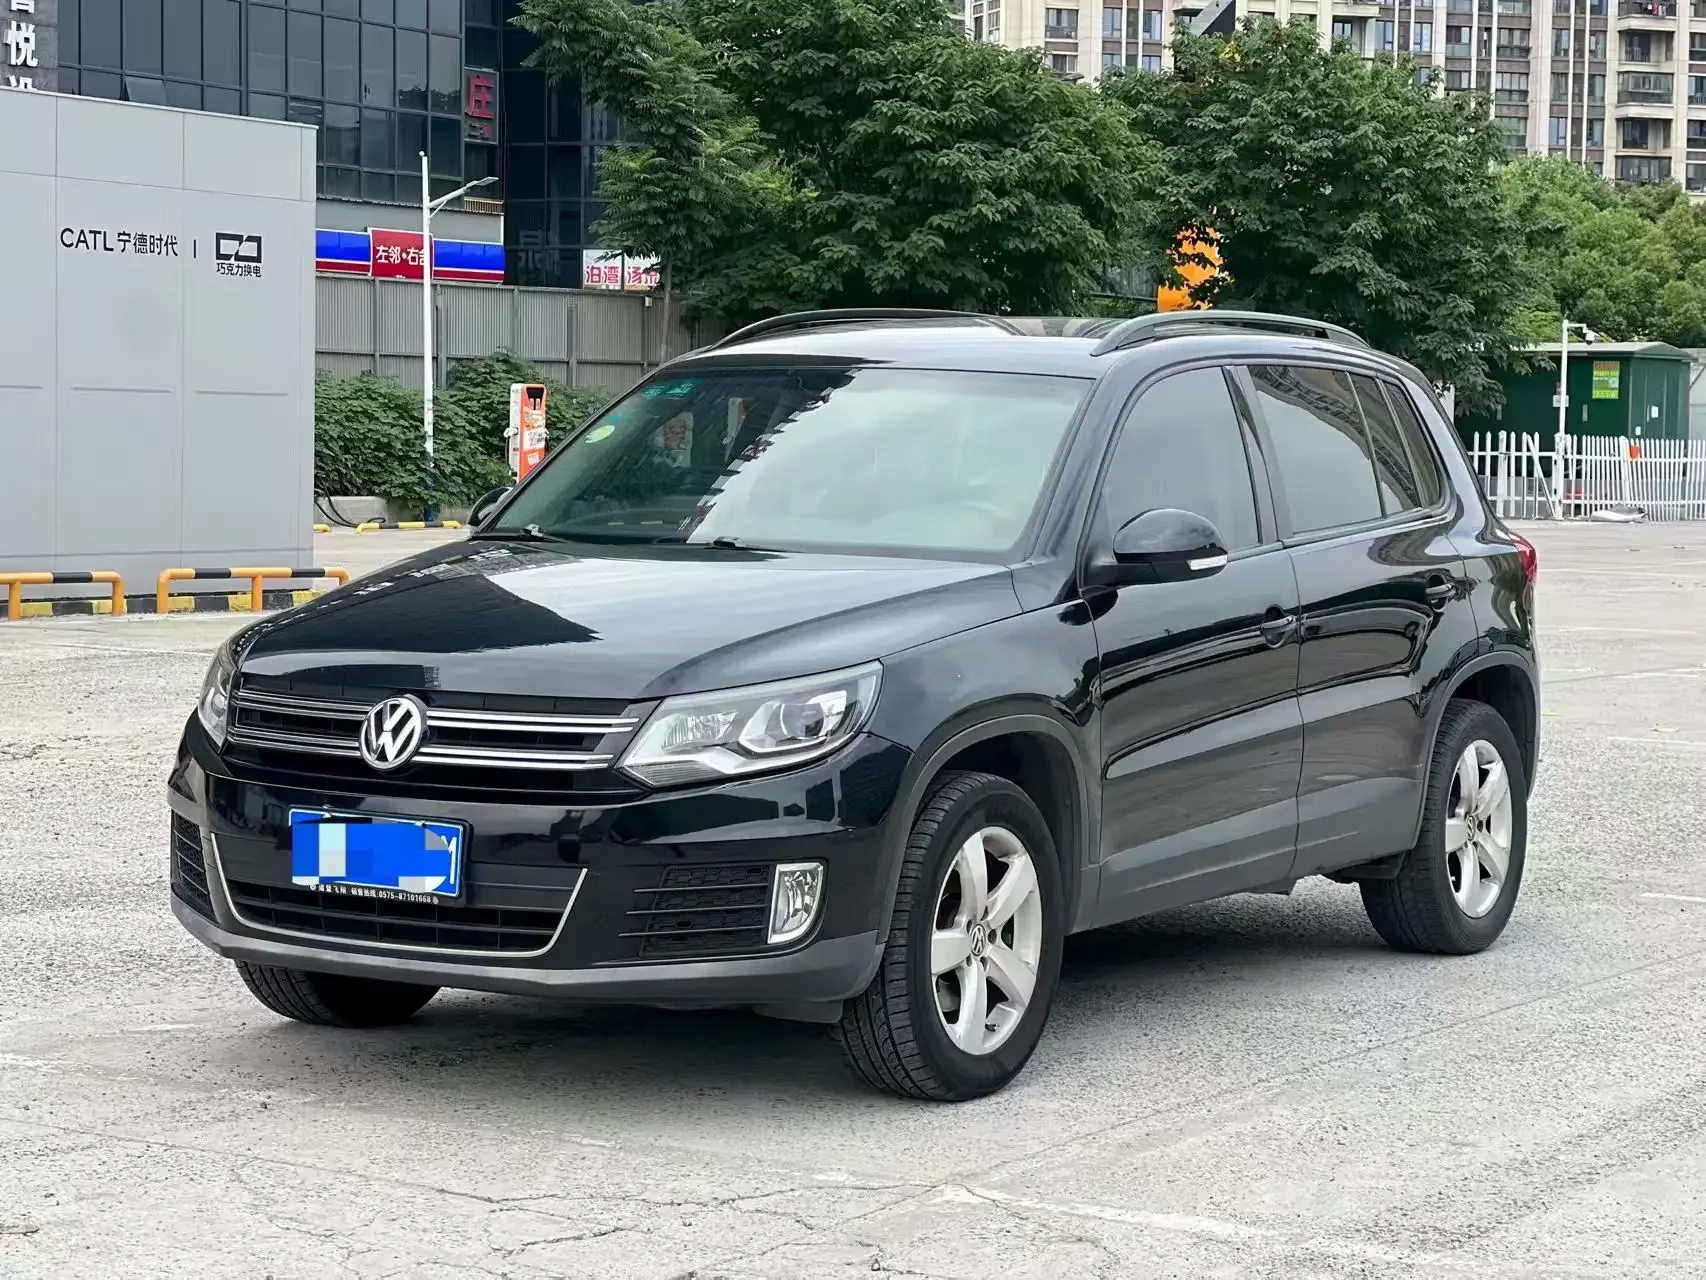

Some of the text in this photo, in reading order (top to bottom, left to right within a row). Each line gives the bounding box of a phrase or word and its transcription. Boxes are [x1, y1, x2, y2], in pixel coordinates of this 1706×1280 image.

[60, 227, 179, 257] CATL 宁德时代
[216, 262, 262, 278] 巧克力换电
